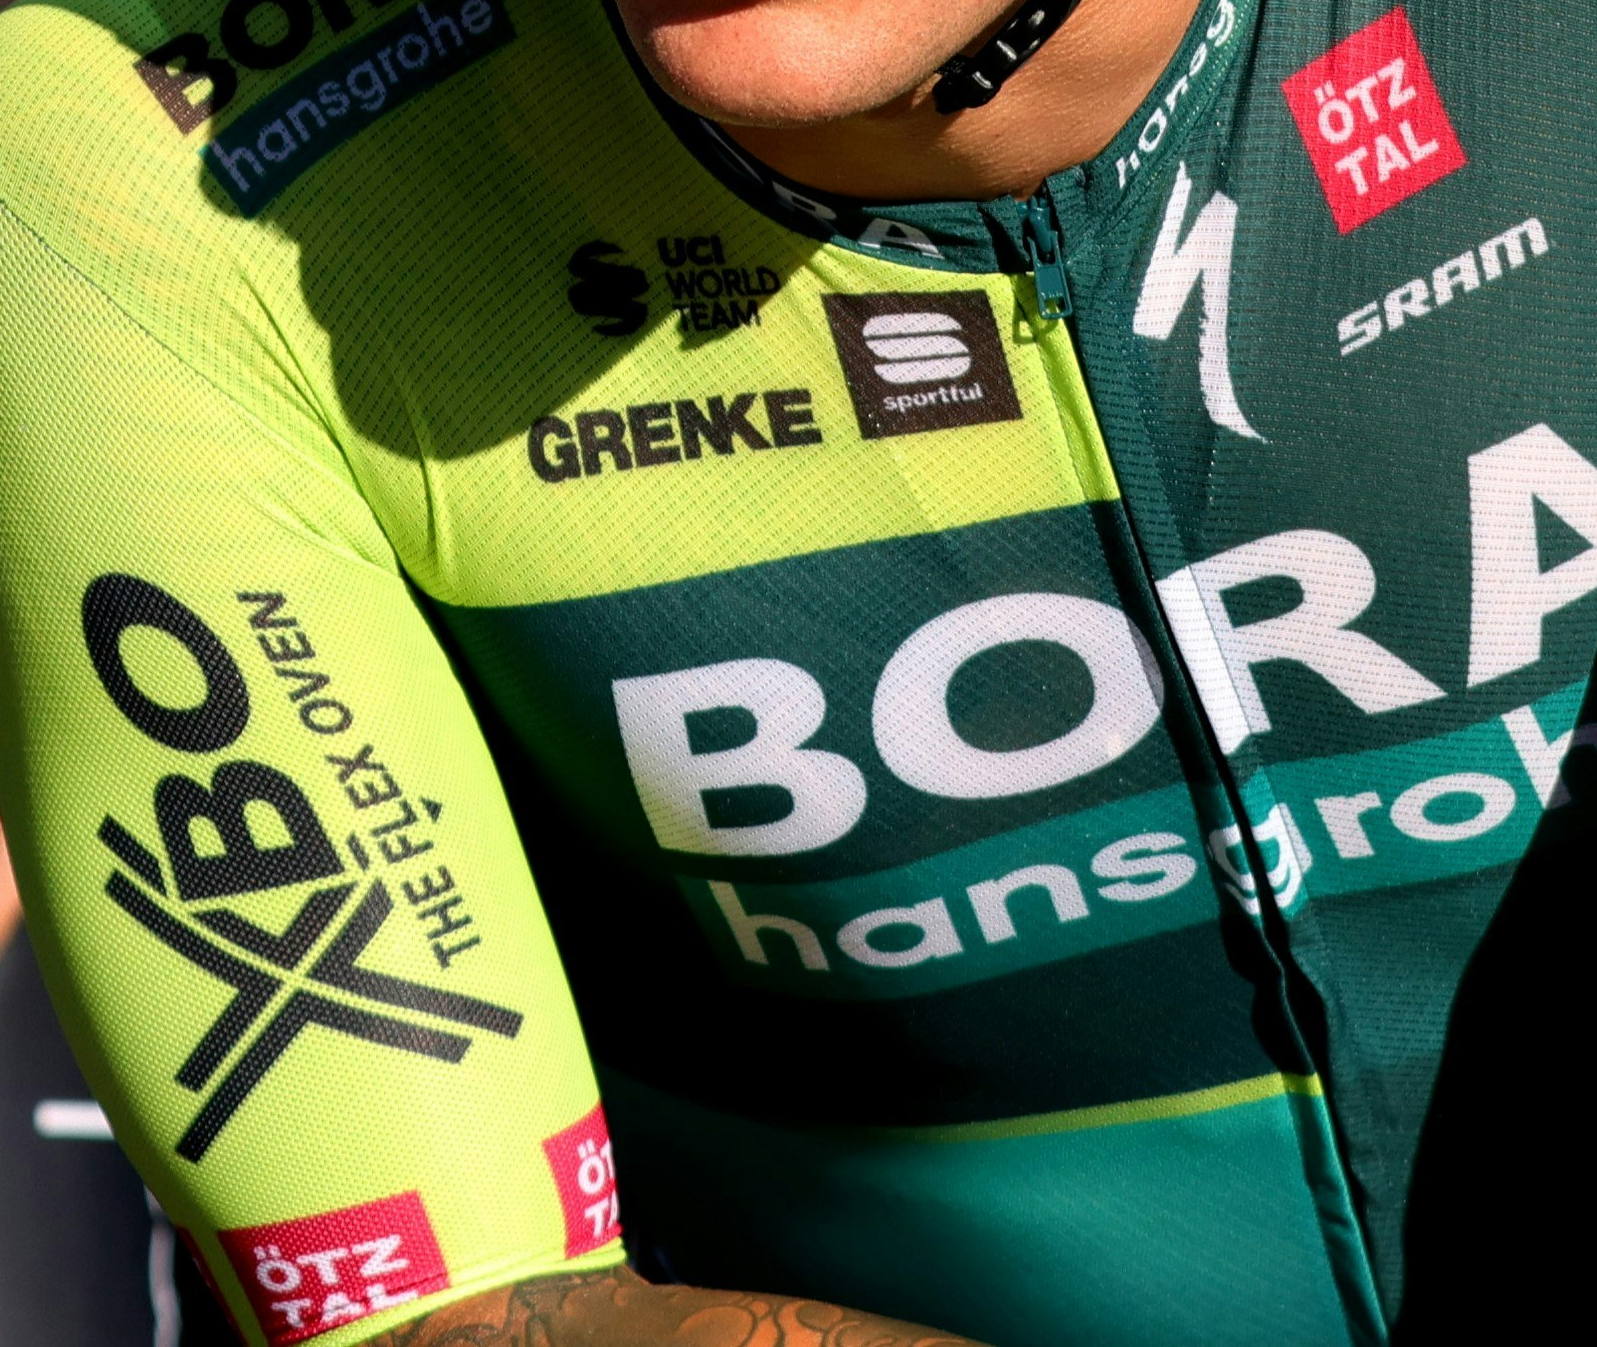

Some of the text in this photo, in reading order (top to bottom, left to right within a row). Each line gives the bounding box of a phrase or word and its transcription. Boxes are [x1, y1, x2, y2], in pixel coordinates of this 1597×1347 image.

[1313, 57, 1417, 144] ÖTZ
[1334, 120, 1440, 197] TAL
[656, 234, 726, 268] UCI
[664, 266, 781, 301] WORLD
[671, 299, 761, 334] TEAM
[1336, 215, 1551, 358] SRAM
[883, 381, 984, 413] sportful
[526, 387, 824, 484] GRENKE
[236, 590, 482, 970] THE FLEX OVEN
[81, 570, 525, 1165] XBO
[253, 1233, 411, 1294] ÖTZ
[270, 1282, 420, 1329] TAL
